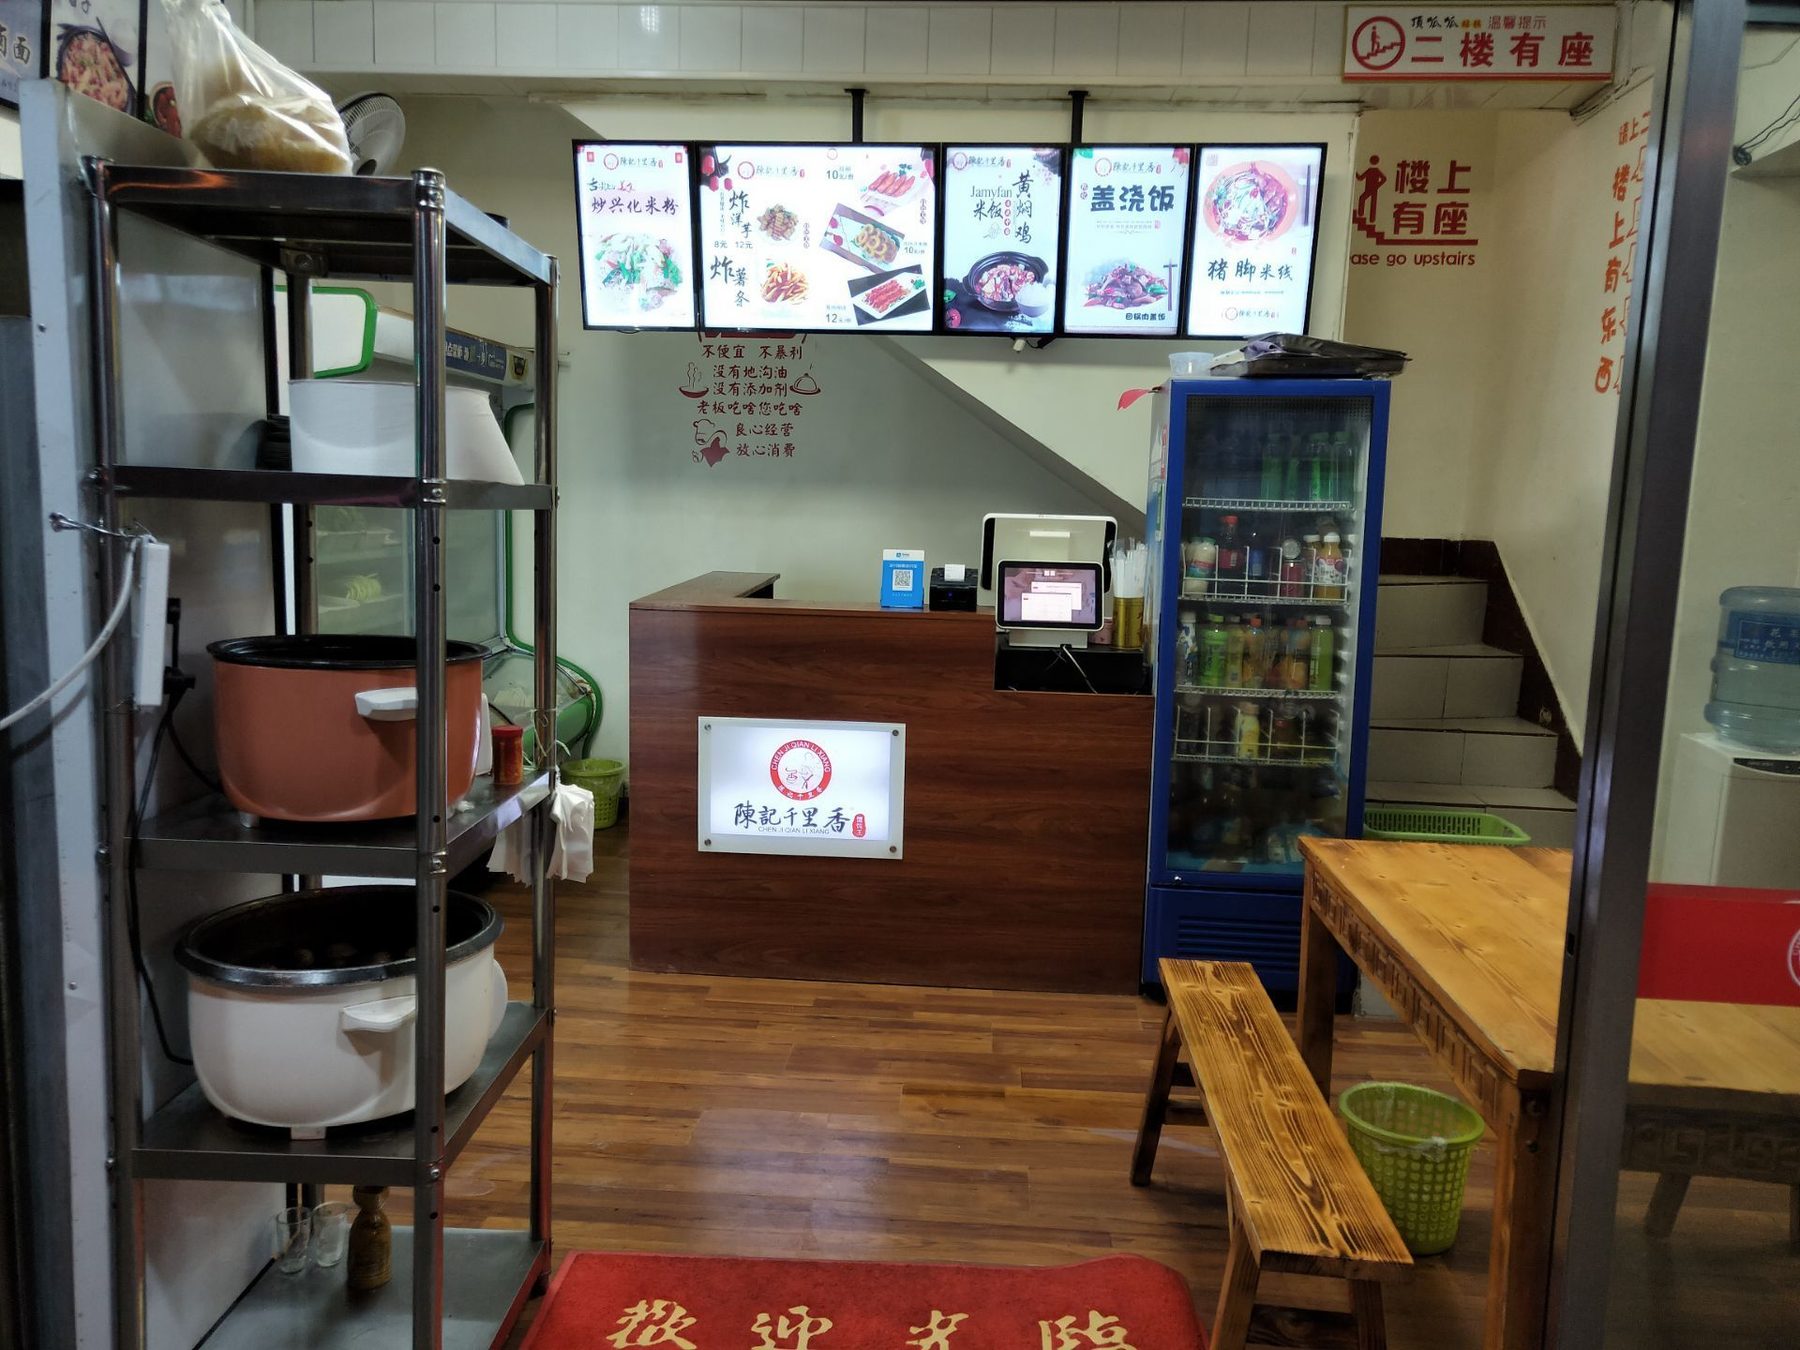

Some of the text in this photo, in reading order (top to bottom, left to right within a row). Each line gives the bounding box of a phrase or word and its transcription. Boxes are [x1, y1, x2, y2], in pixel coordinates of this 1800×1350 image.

[1411, 31, 1594, 68] 二楼有座
[1395, 160, 1471, 194] 楼上
[592, 196, 679, 216] 炒兴化米粉
[1012, 169, 1034, 244] 黄焖鸡
[1090, 184, 1175, 212] 盖浇饭
[974, 199, 1004, 221] 米饭
[1393, 201, 1469, 235] 有座
[714, 240, 753, 249] 8元 12元
[1350, 251, 1475, 267] ase go upstairs
[1207, 258, 1293, 283] 猪脚米线
[701, 344, 803, 360] 不便宜 不暴利
[713, 364, 788, 379] 没有地沟油
[713, 382, 788, 397] 没有添加剂
[697, 400, 803, 416] 老板吃啥您吃啥
[735, 423, 794, 437] 良心经营
[736, 443, 796, 458] 放心消费
[790, 740, 810, 748] QIAN
[734, 800, 851, 833] 陳記千里香
